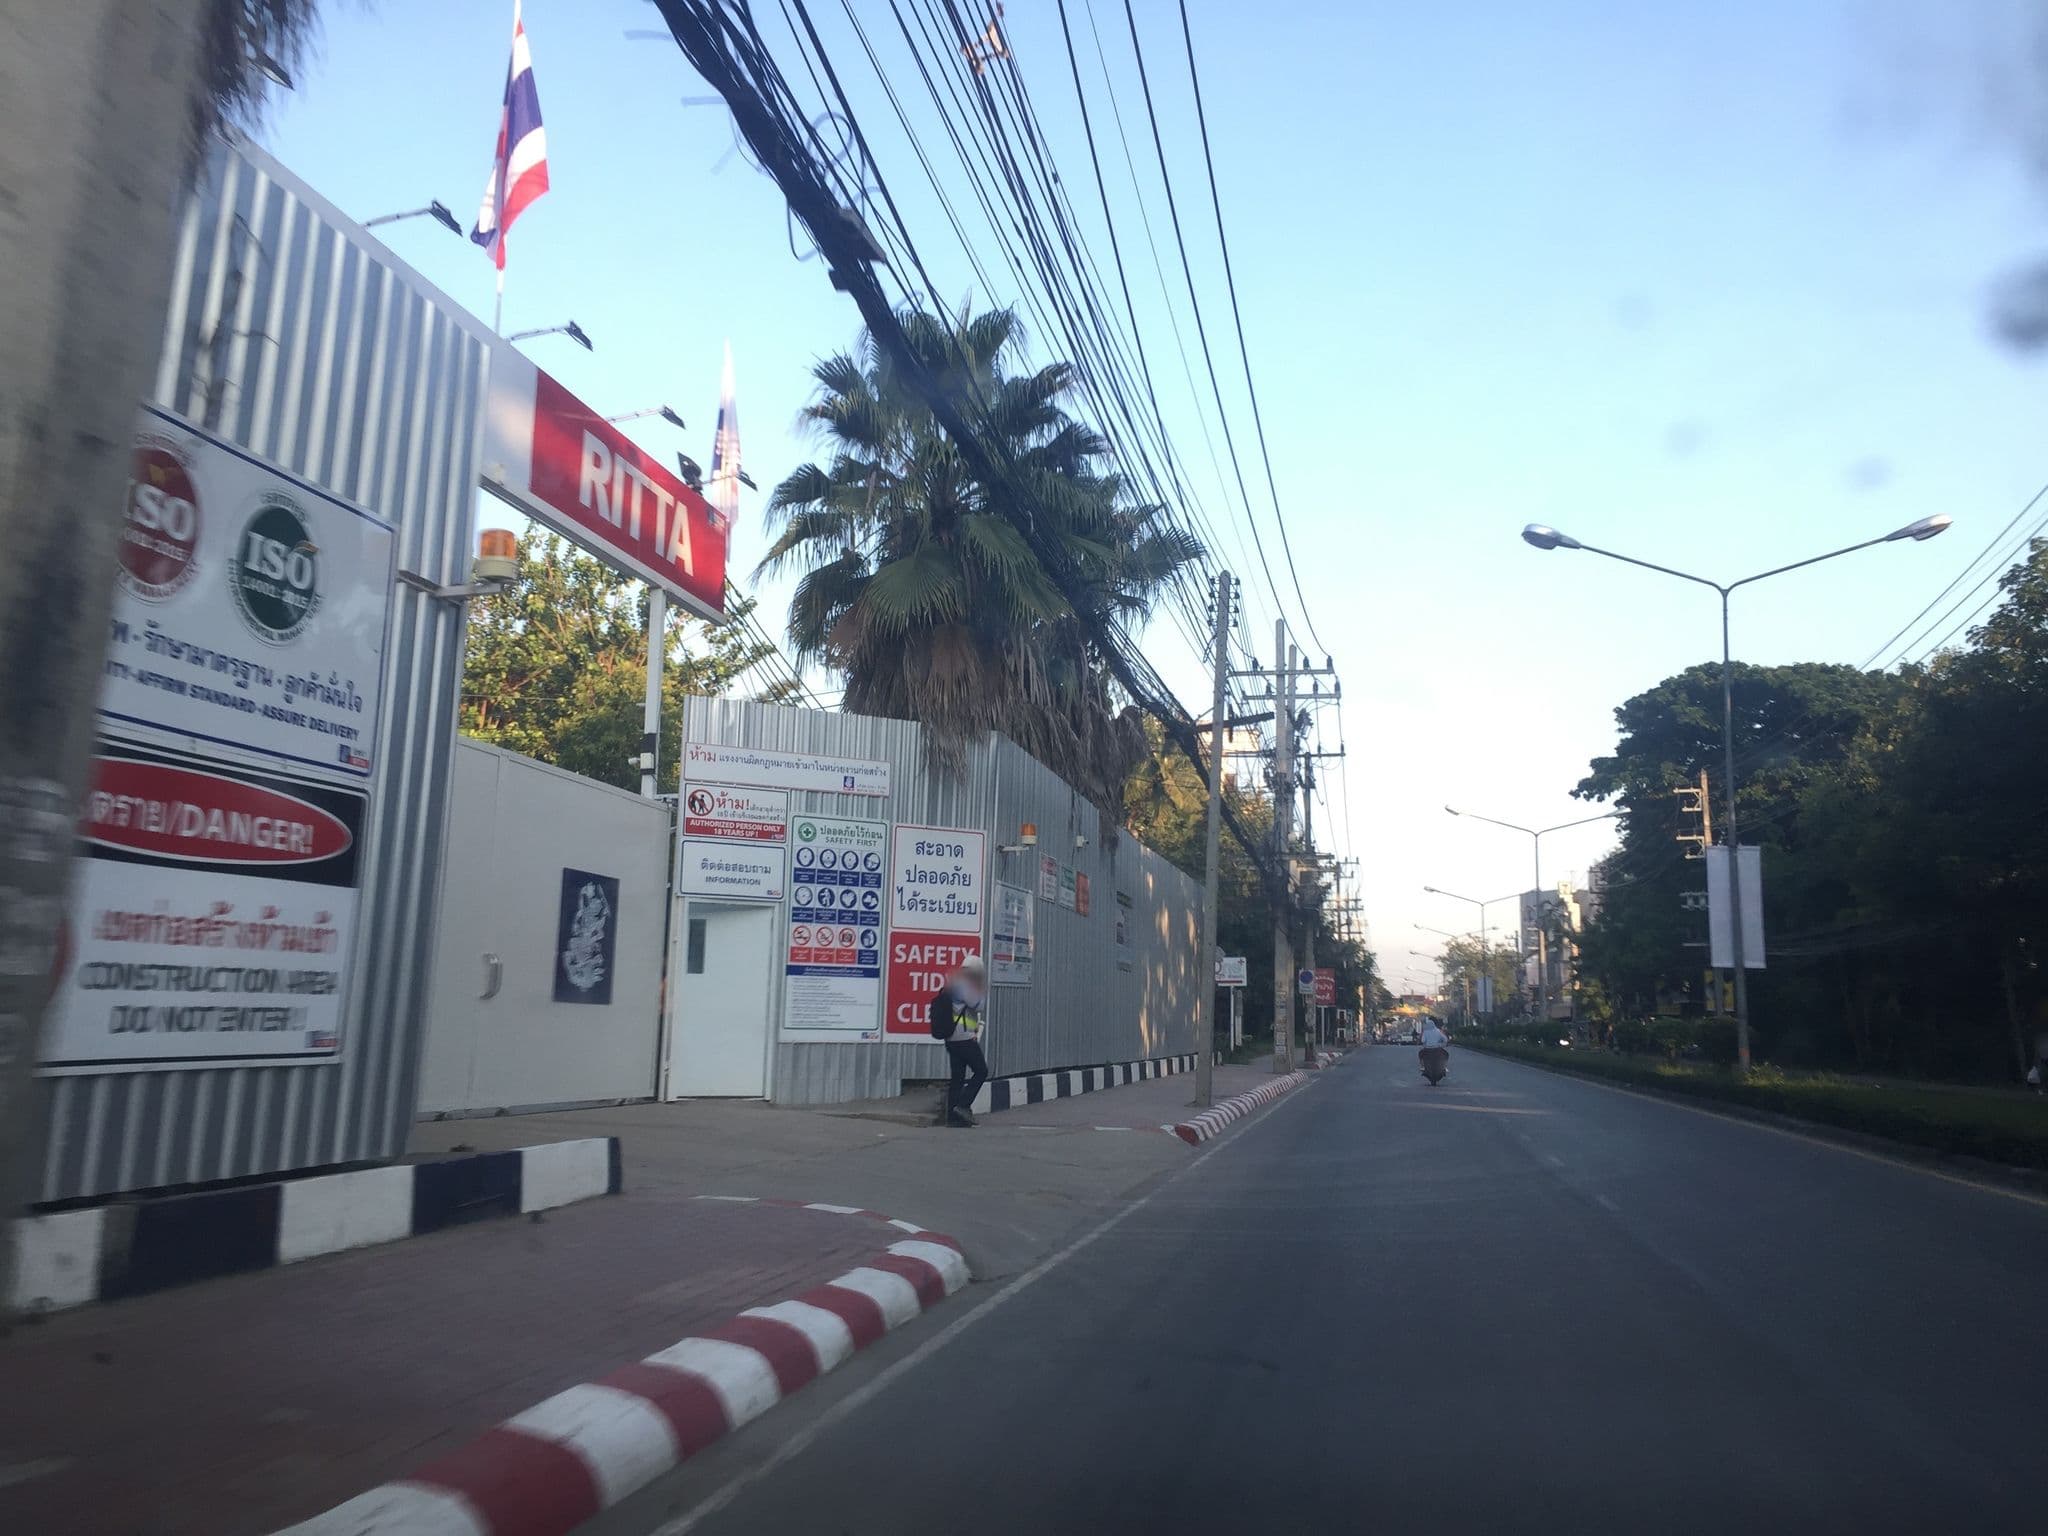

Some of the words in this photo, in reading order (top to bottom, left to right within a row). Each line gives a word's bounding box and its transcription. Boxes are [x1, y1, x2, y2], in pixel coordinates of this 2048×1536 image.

[579, 428, 694, 577] RITTA
[244, 530, 312, 590] ISO
[309, 716, 360, 741] DELIVERY
[689, 745, 716, 763] ห้าม
[690, 819, 735, 829] AUTHORIZED
[736, 822, 762, 831] PERSON
[763, 825, 781, 833] ONLY
[724, 829, 745, 837] YEARS
[820, 824, 883, 840] ปลอดภัยไว้ก่อน
[825, 836, 854, 845] SAFETY
[856, 839, 878, 847] FIRST
[915, 840, 965, 859] สะอาด
[701, 857, 772, 874] ติดต่อสอบถาม
[905, 864, 972, 888] ปลอดภัย
[705, 876, 761, 886] INFORMATION
[896, 886, 978, 916] ได้ระเบียบ
[79, 961, 281, 994] CONSTRUCTION
[908, 971, 949, 992] TID
[109, 1005, 152, 1034] DO
[155, 1005, 211, 1033] NOT
[897, 1002, 933, 1024] CLE
